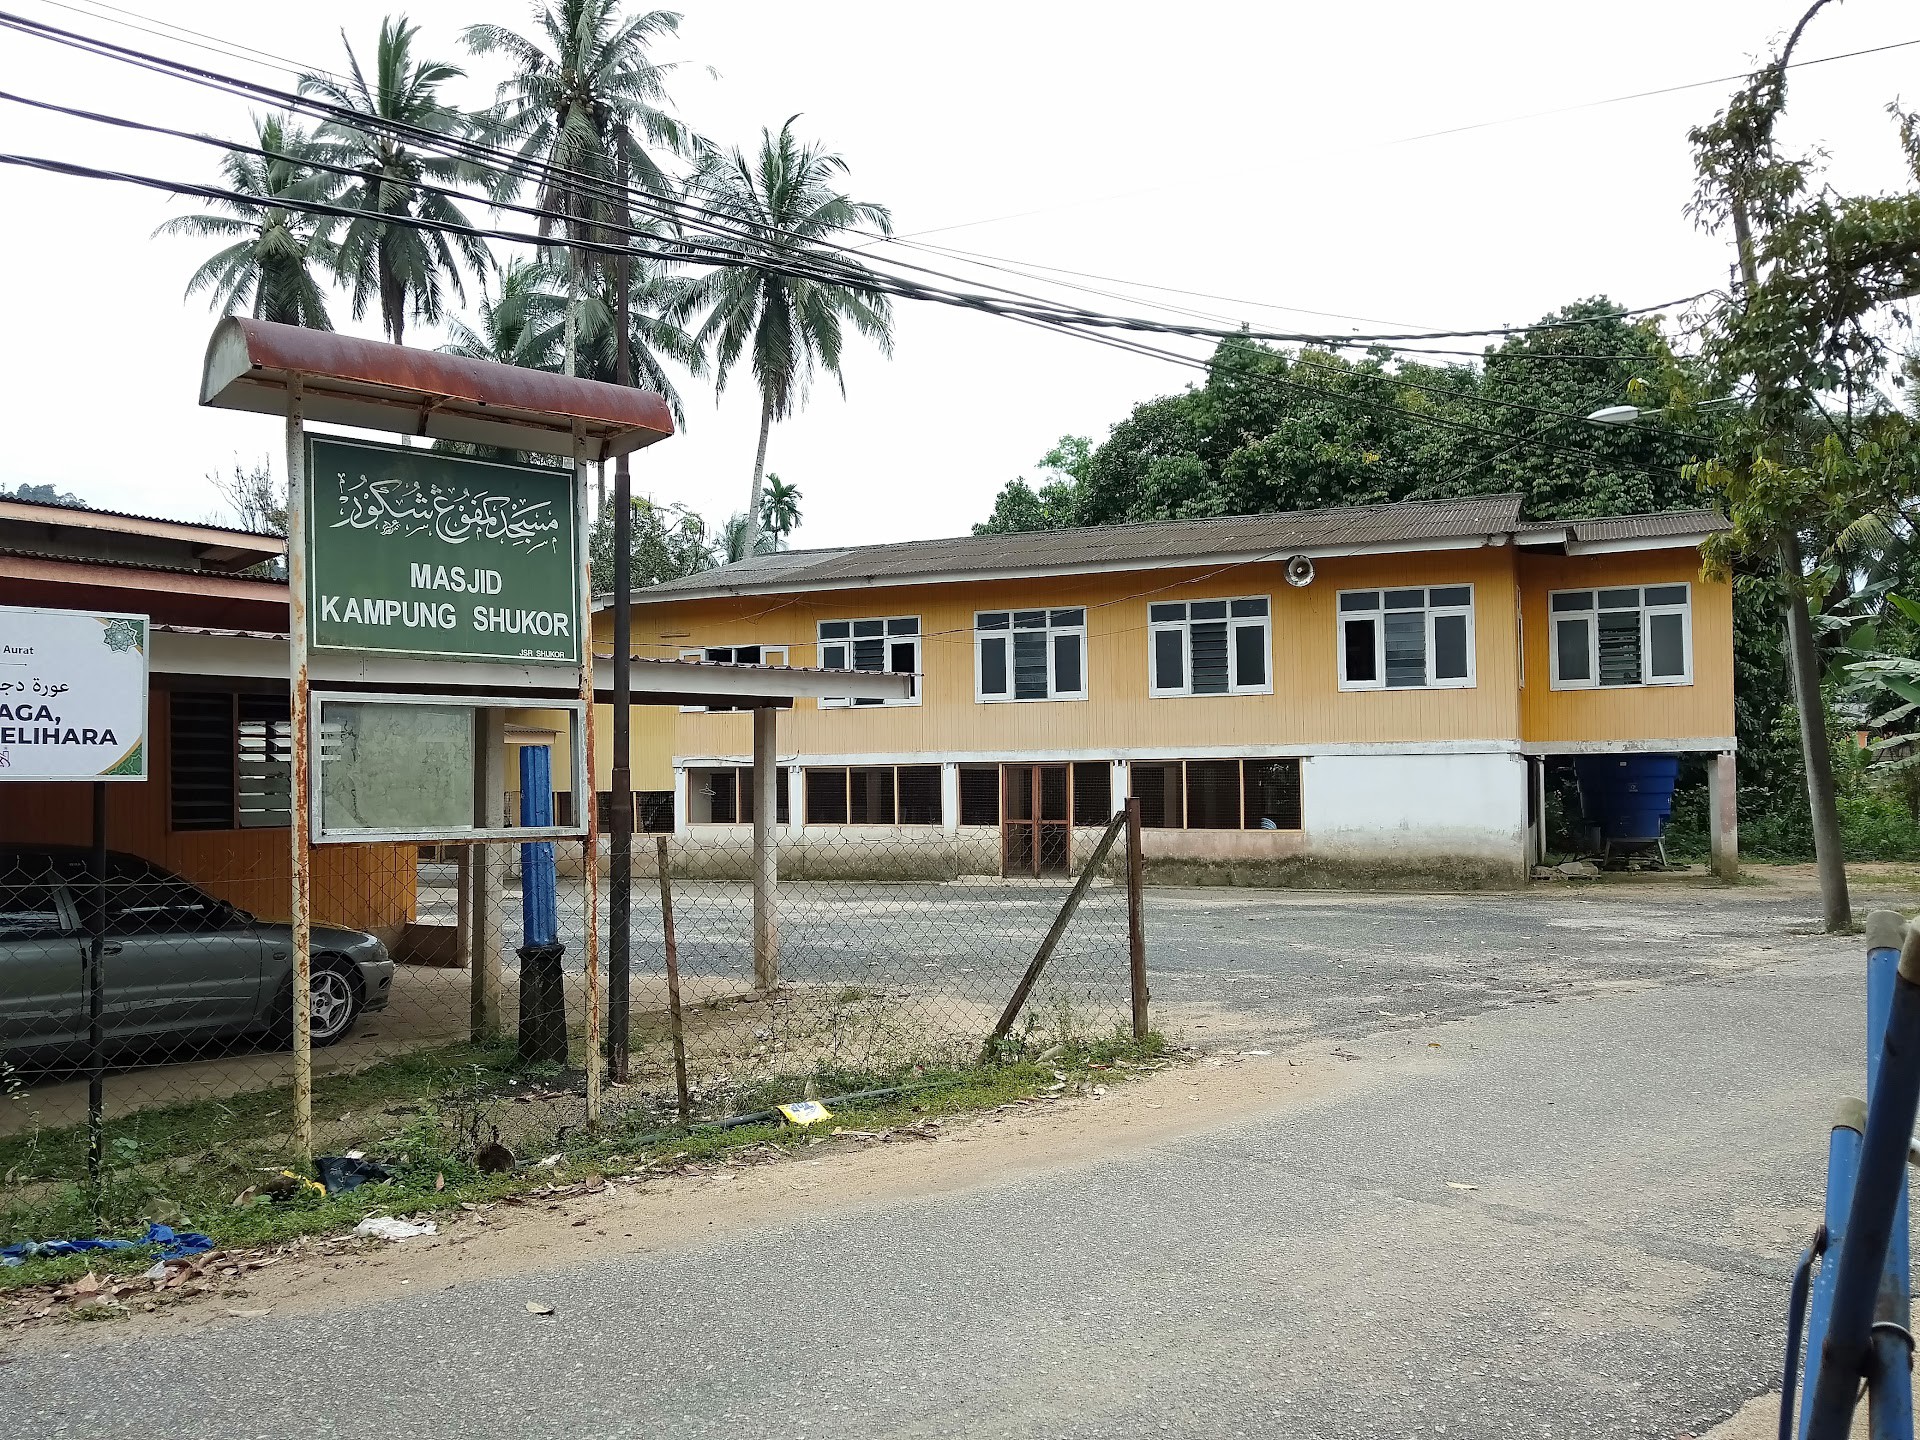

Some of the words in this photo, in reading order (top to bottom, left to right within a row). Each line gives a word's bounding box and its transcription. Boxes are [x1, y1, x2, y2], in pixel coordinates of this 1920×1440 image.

[410, 562, 503, 595] MASJID
[321, 595, 457, 629] KAMPUNG
[473, 605, 570, 637] SHUKOR
[3, 645, 34, 655] Aurat
[519, 649, 533, 657] JSR
[535, 649, 565, 659] SHUKOR
[0, 681, 24, 696] دج
[33, 677, 69, 698] عورة
[0, 703, 61, 726] AGA,
[0, 727, 119, 746] ELIHARA
